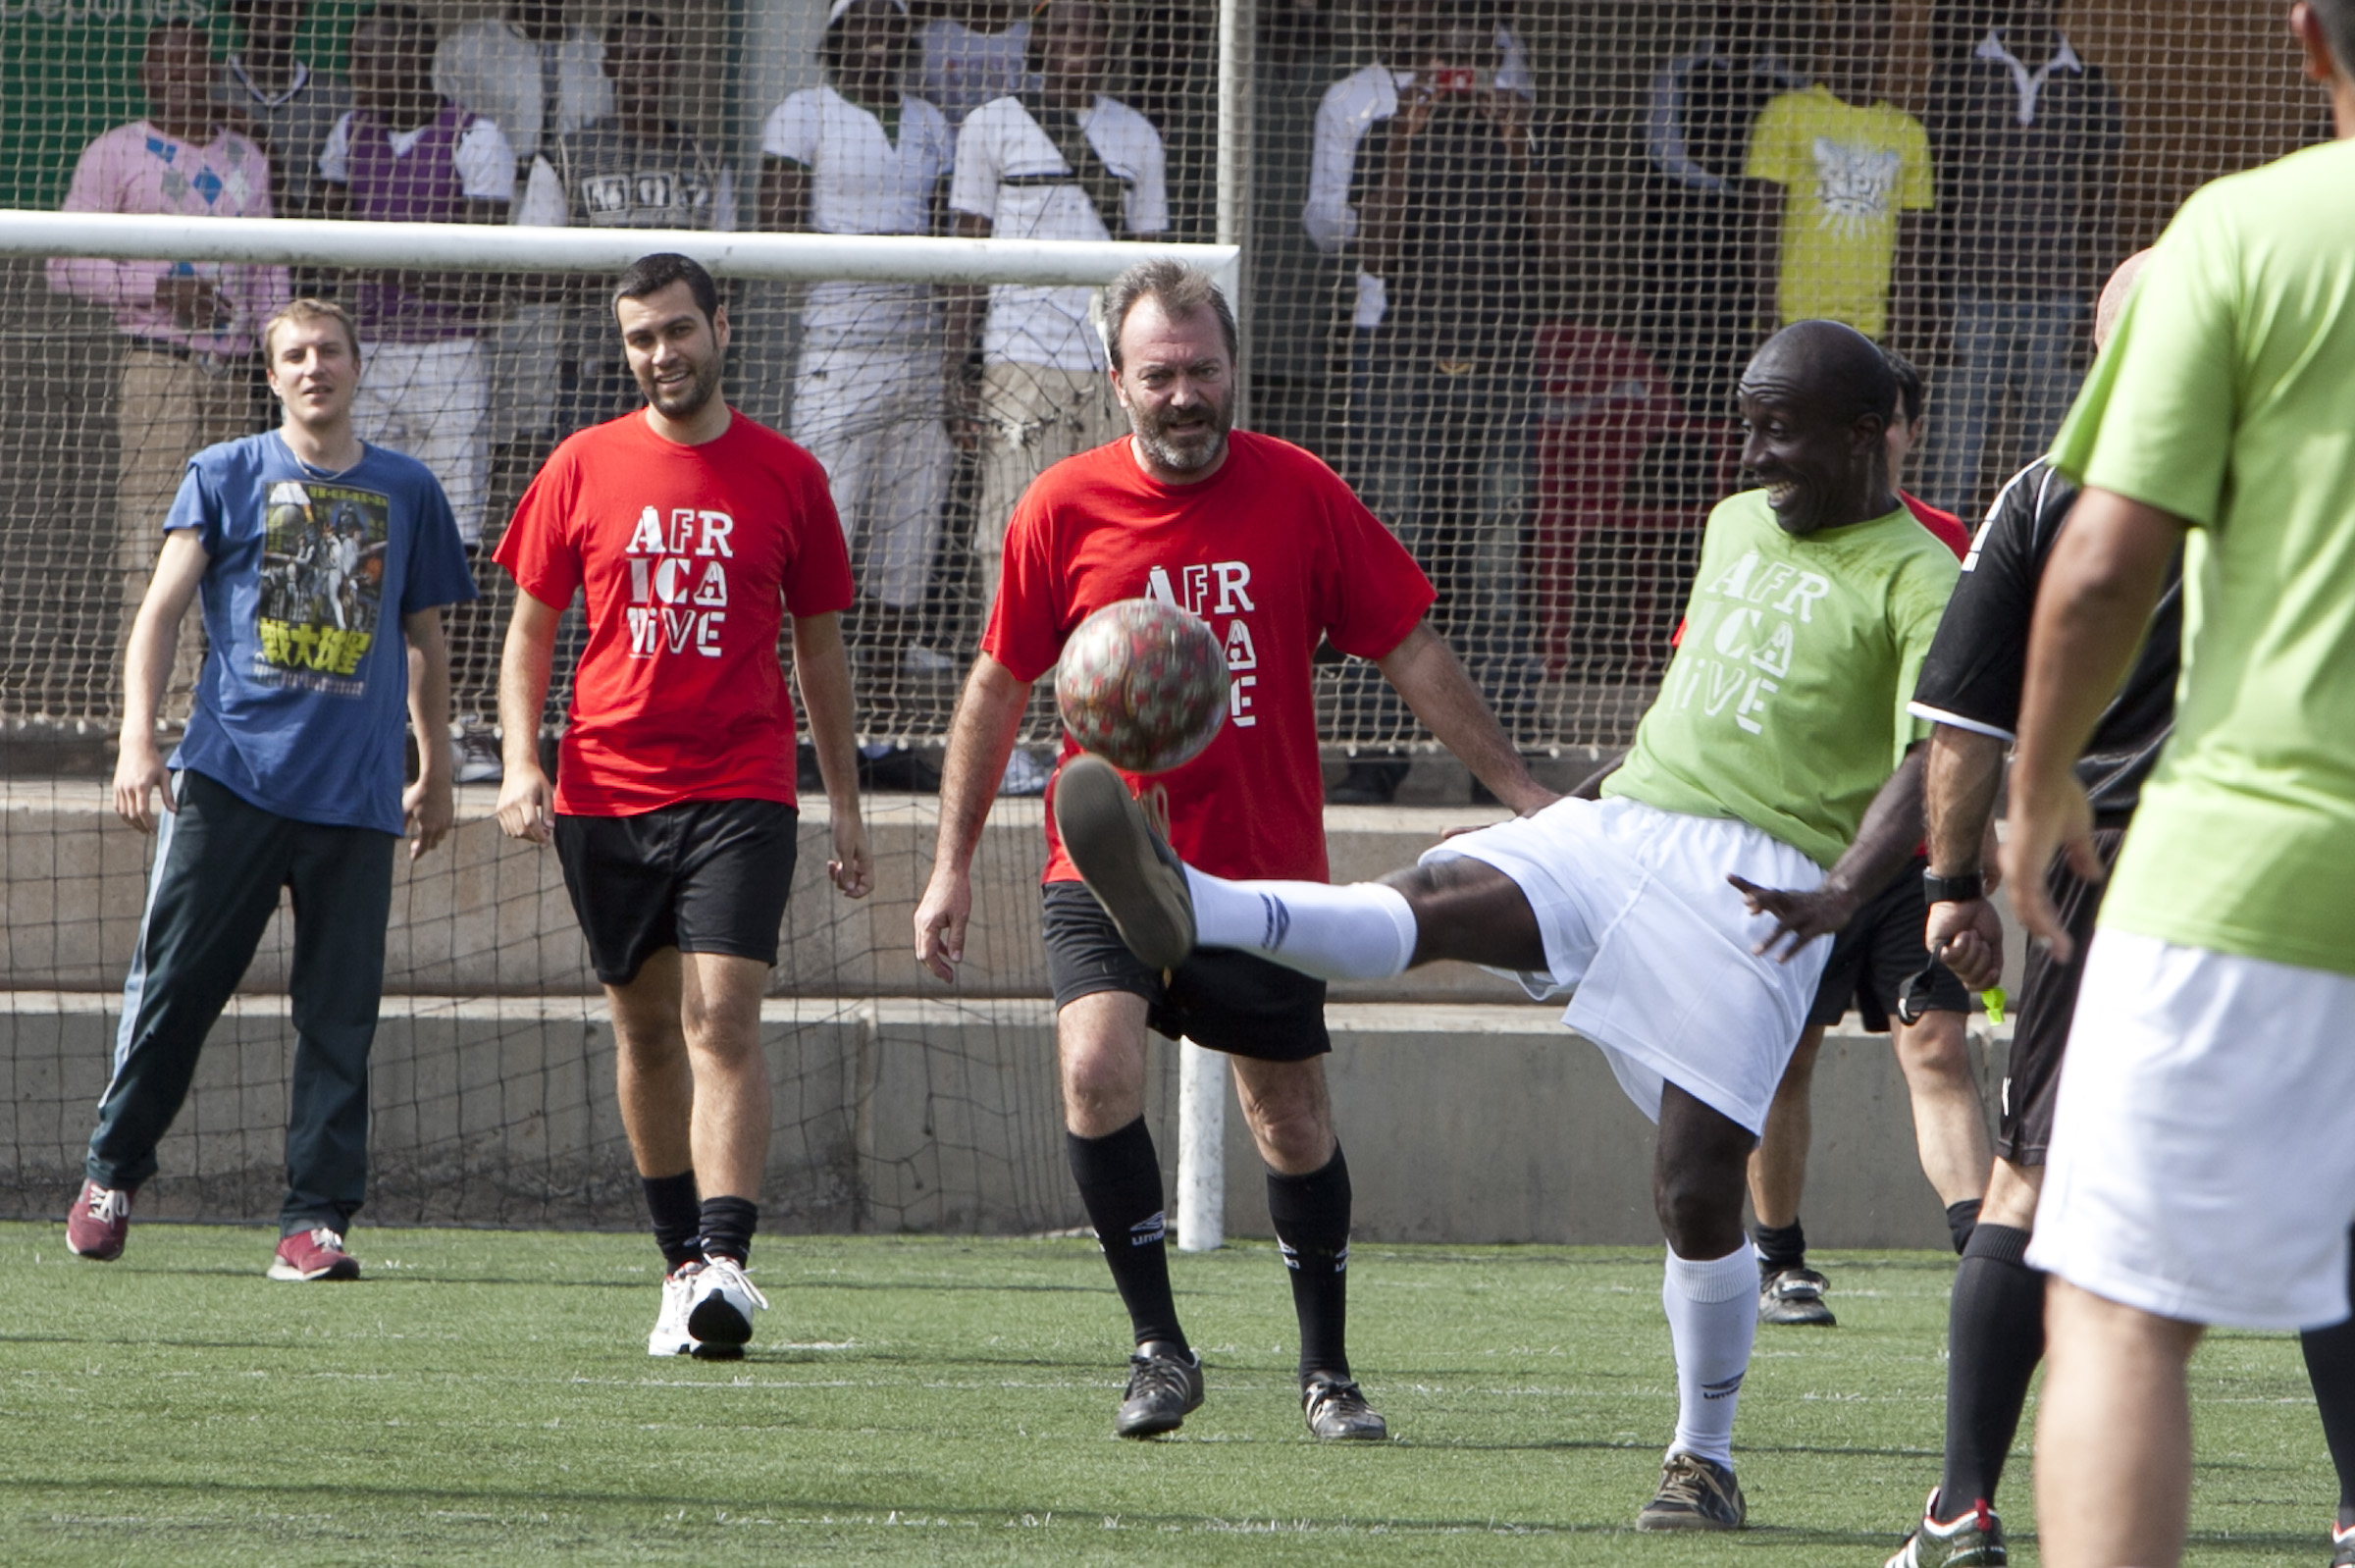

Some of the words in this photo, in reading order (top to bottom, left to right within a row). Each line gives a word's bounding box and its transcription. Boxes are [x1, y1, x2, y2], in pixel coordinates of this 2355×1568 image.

[625, 505, 734, 557] AFR
[626, 557, 728, 606] ICA
[1704, 549, 1830, 624] AFR
[1687, 599, 1794, 679] ICA
